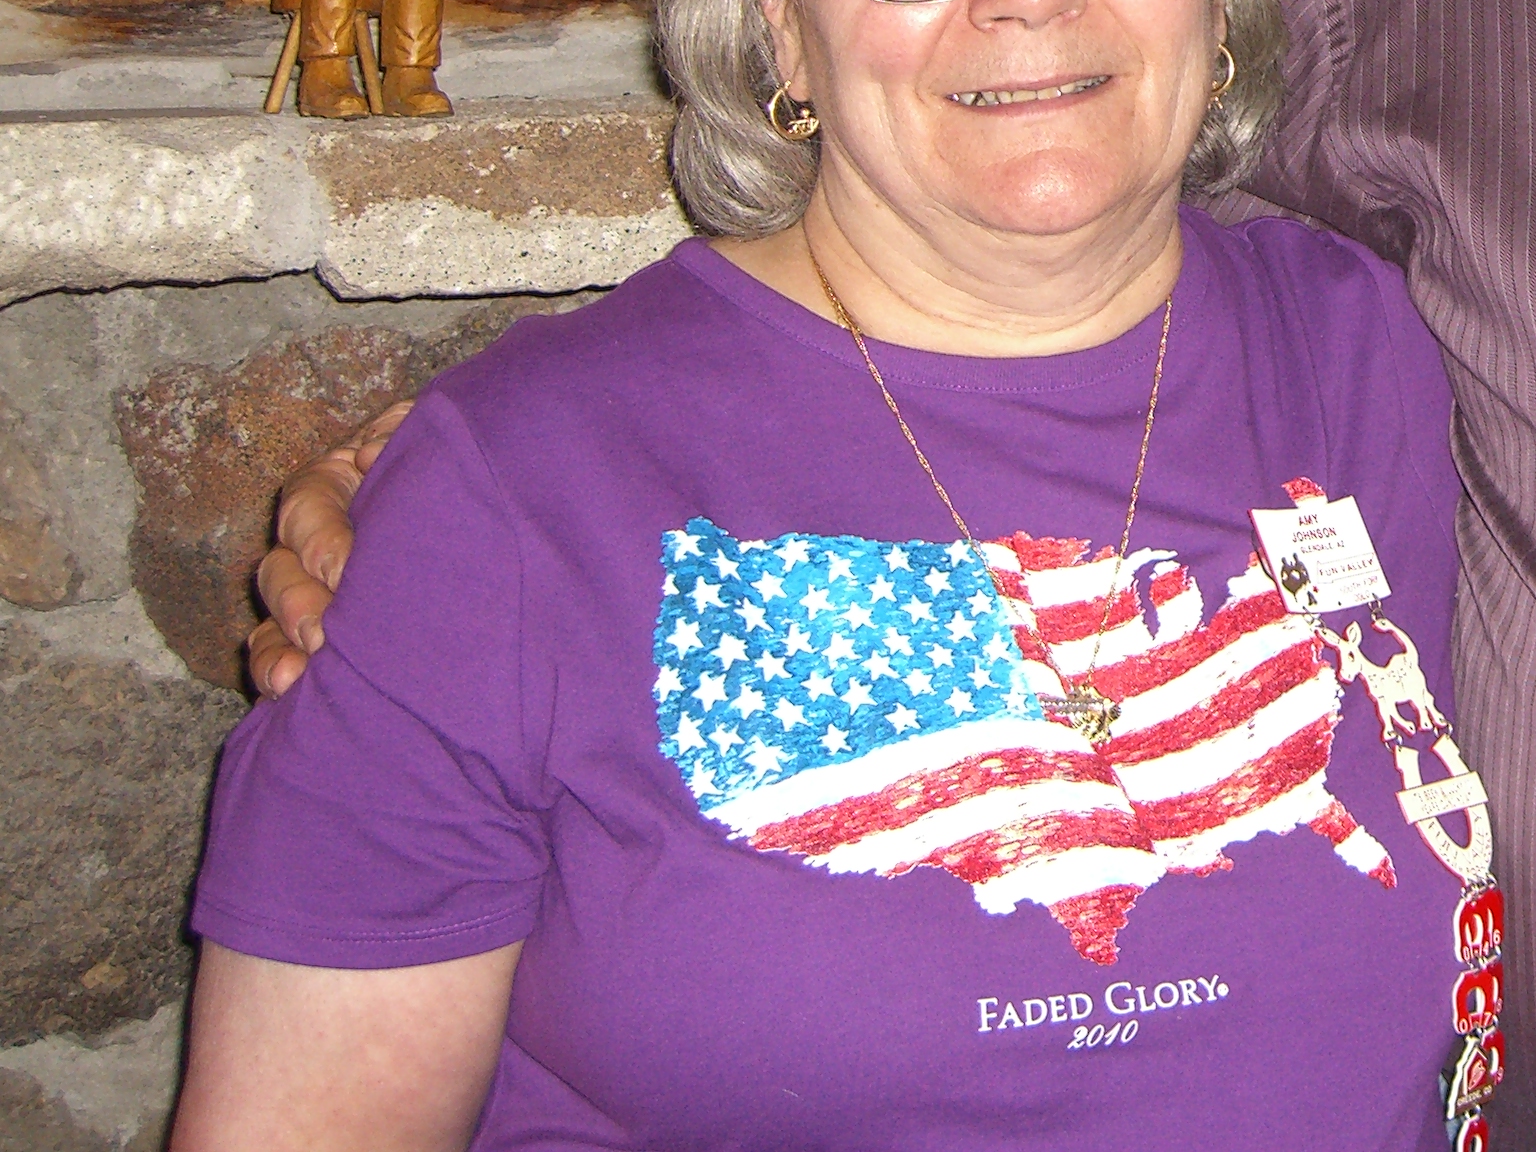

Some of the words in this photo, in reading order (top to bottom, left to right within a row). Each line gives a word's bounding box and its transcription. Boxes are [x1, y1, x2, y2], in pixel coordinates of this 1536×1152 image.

[1298, 514, 1318, 527] AMY
[1292, 527, 1337, 543] JOHNSON
[1341, 558, 1374, 573] VALLEY
[977, 992, 1093, 1032] FADED
[1067, 1020, 1139, 1050] 2010
